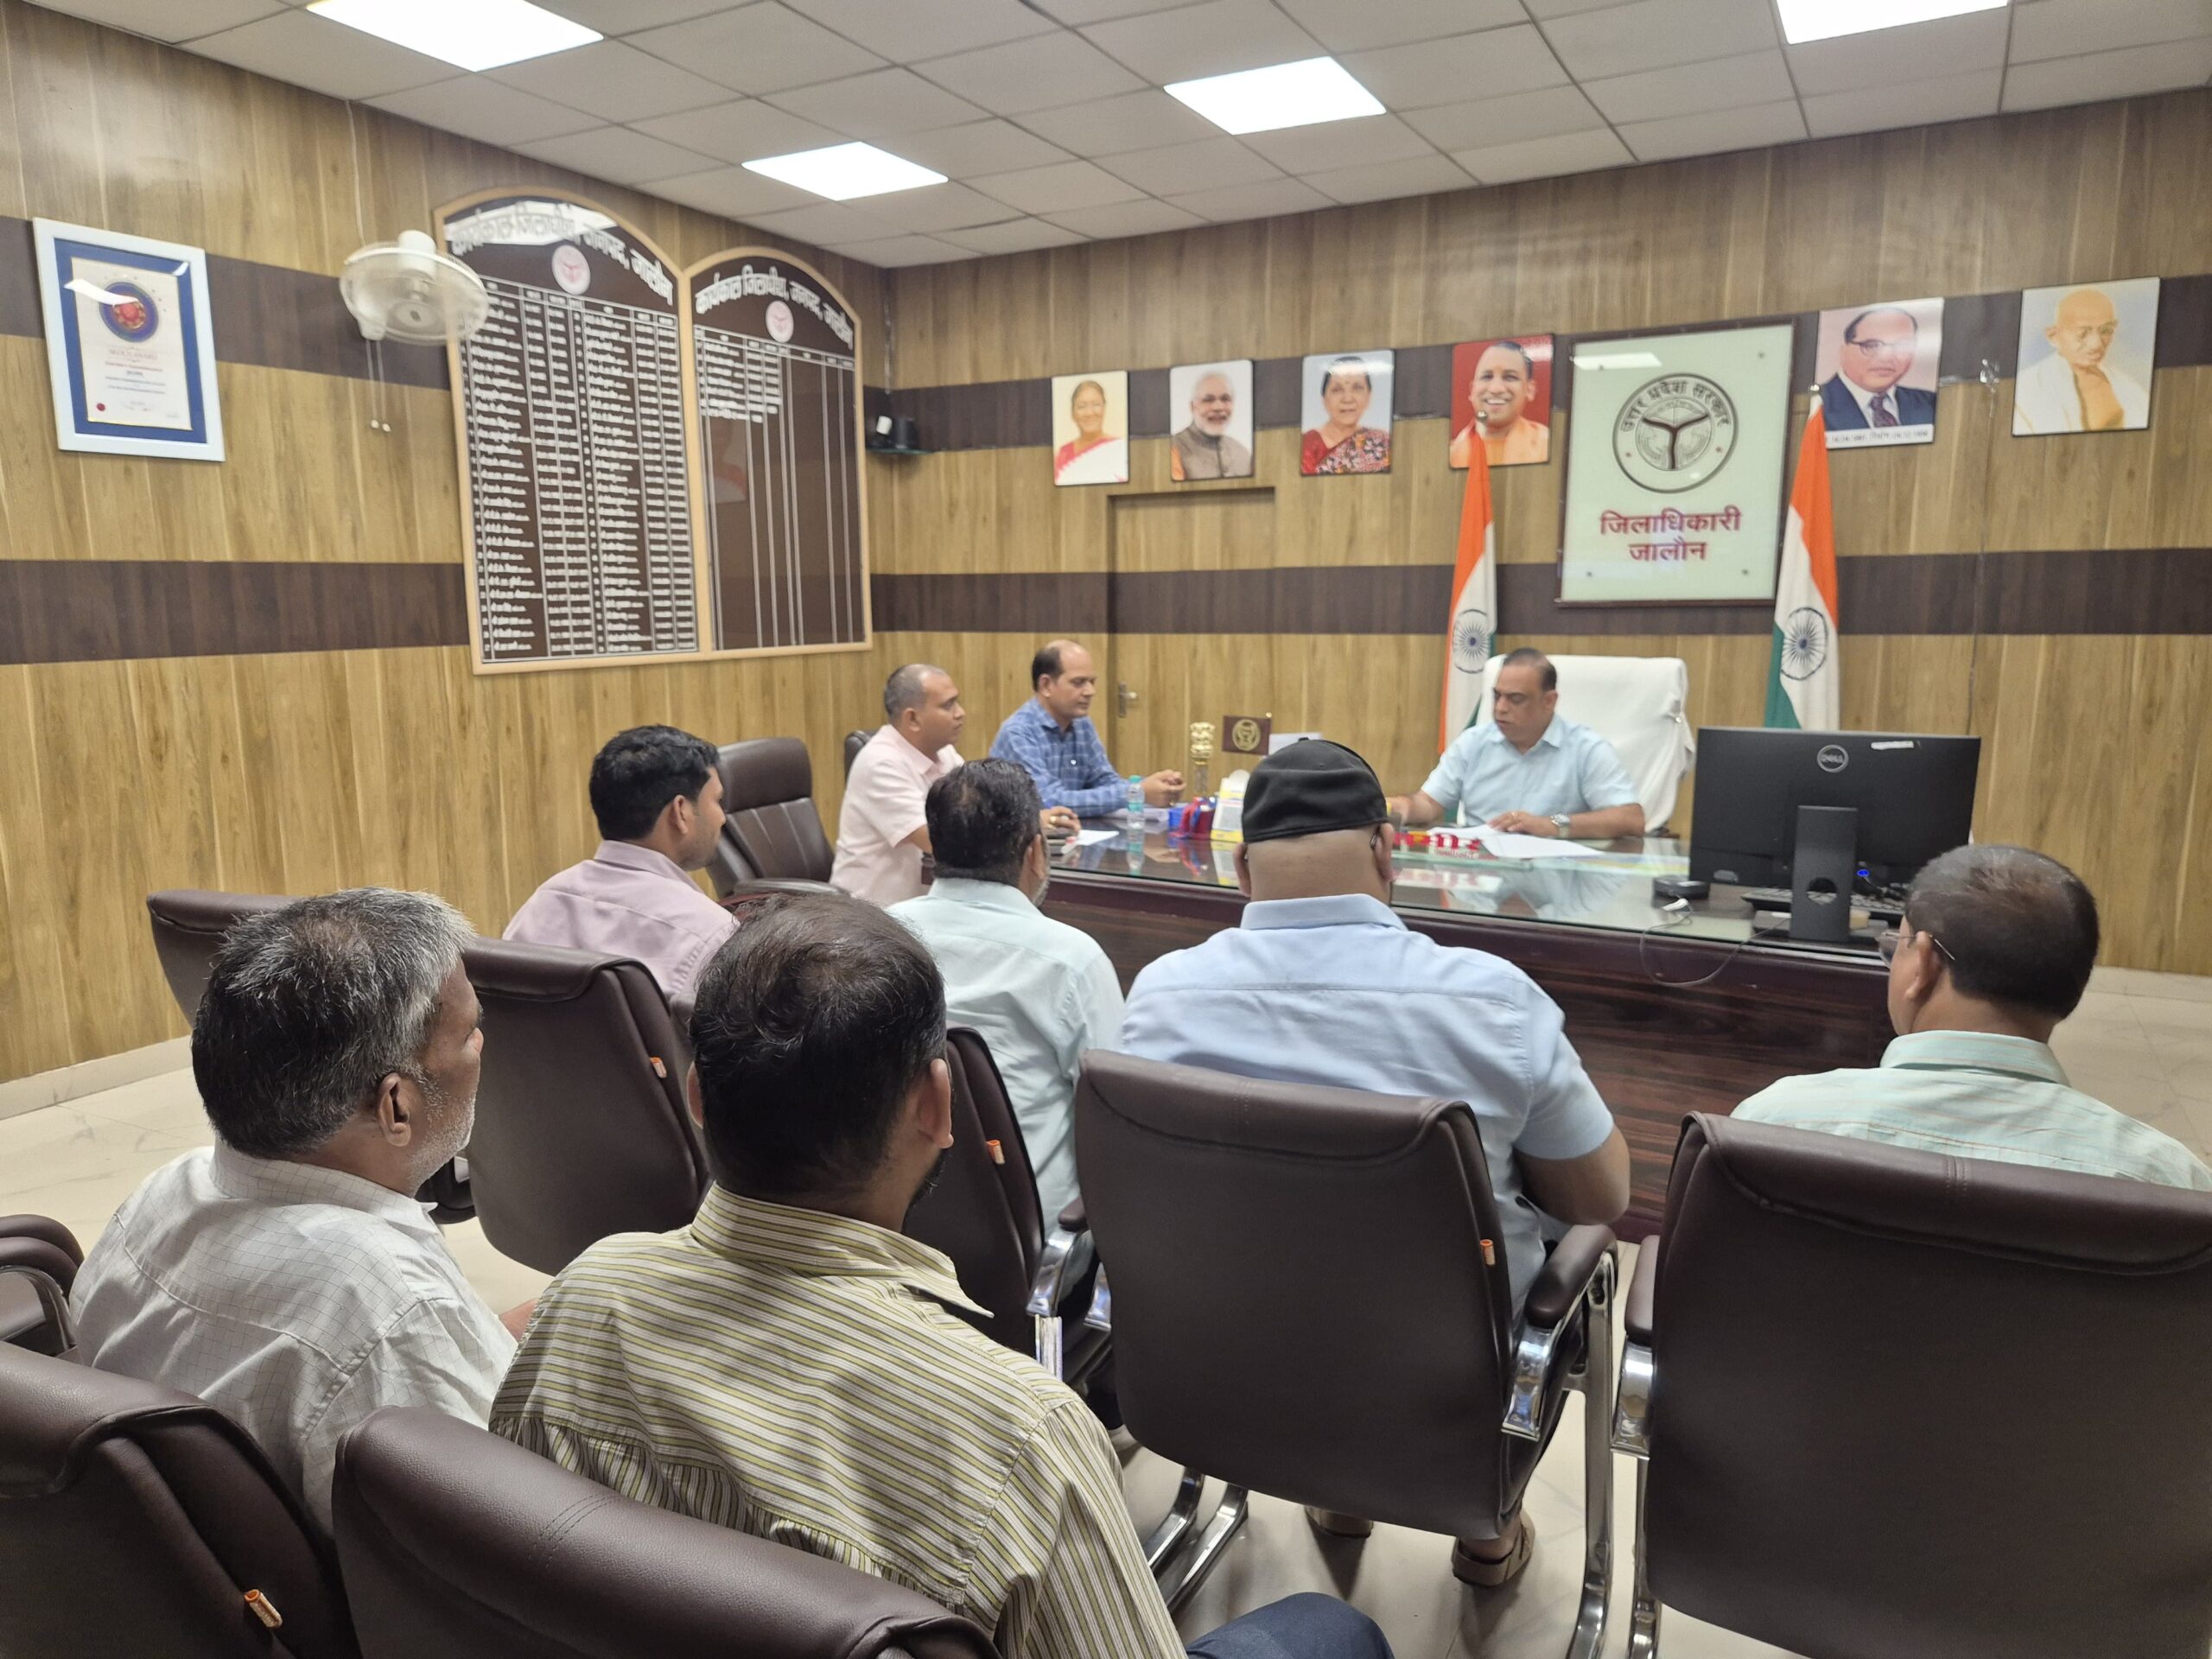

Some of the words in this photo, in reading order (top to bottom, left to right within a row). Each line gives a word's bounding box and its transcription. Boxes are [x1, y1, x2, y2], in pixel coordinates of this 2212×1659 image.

[1620, 397, 1648, 432] उत्तर
[1647, 380, 1688, 400] प्रदेश
[1693, 383, 1730, 427] सरकार
[1600, 505, 1741, 534] जिलाधिकारी
[1629, 536, 1707, 561] जालौन
